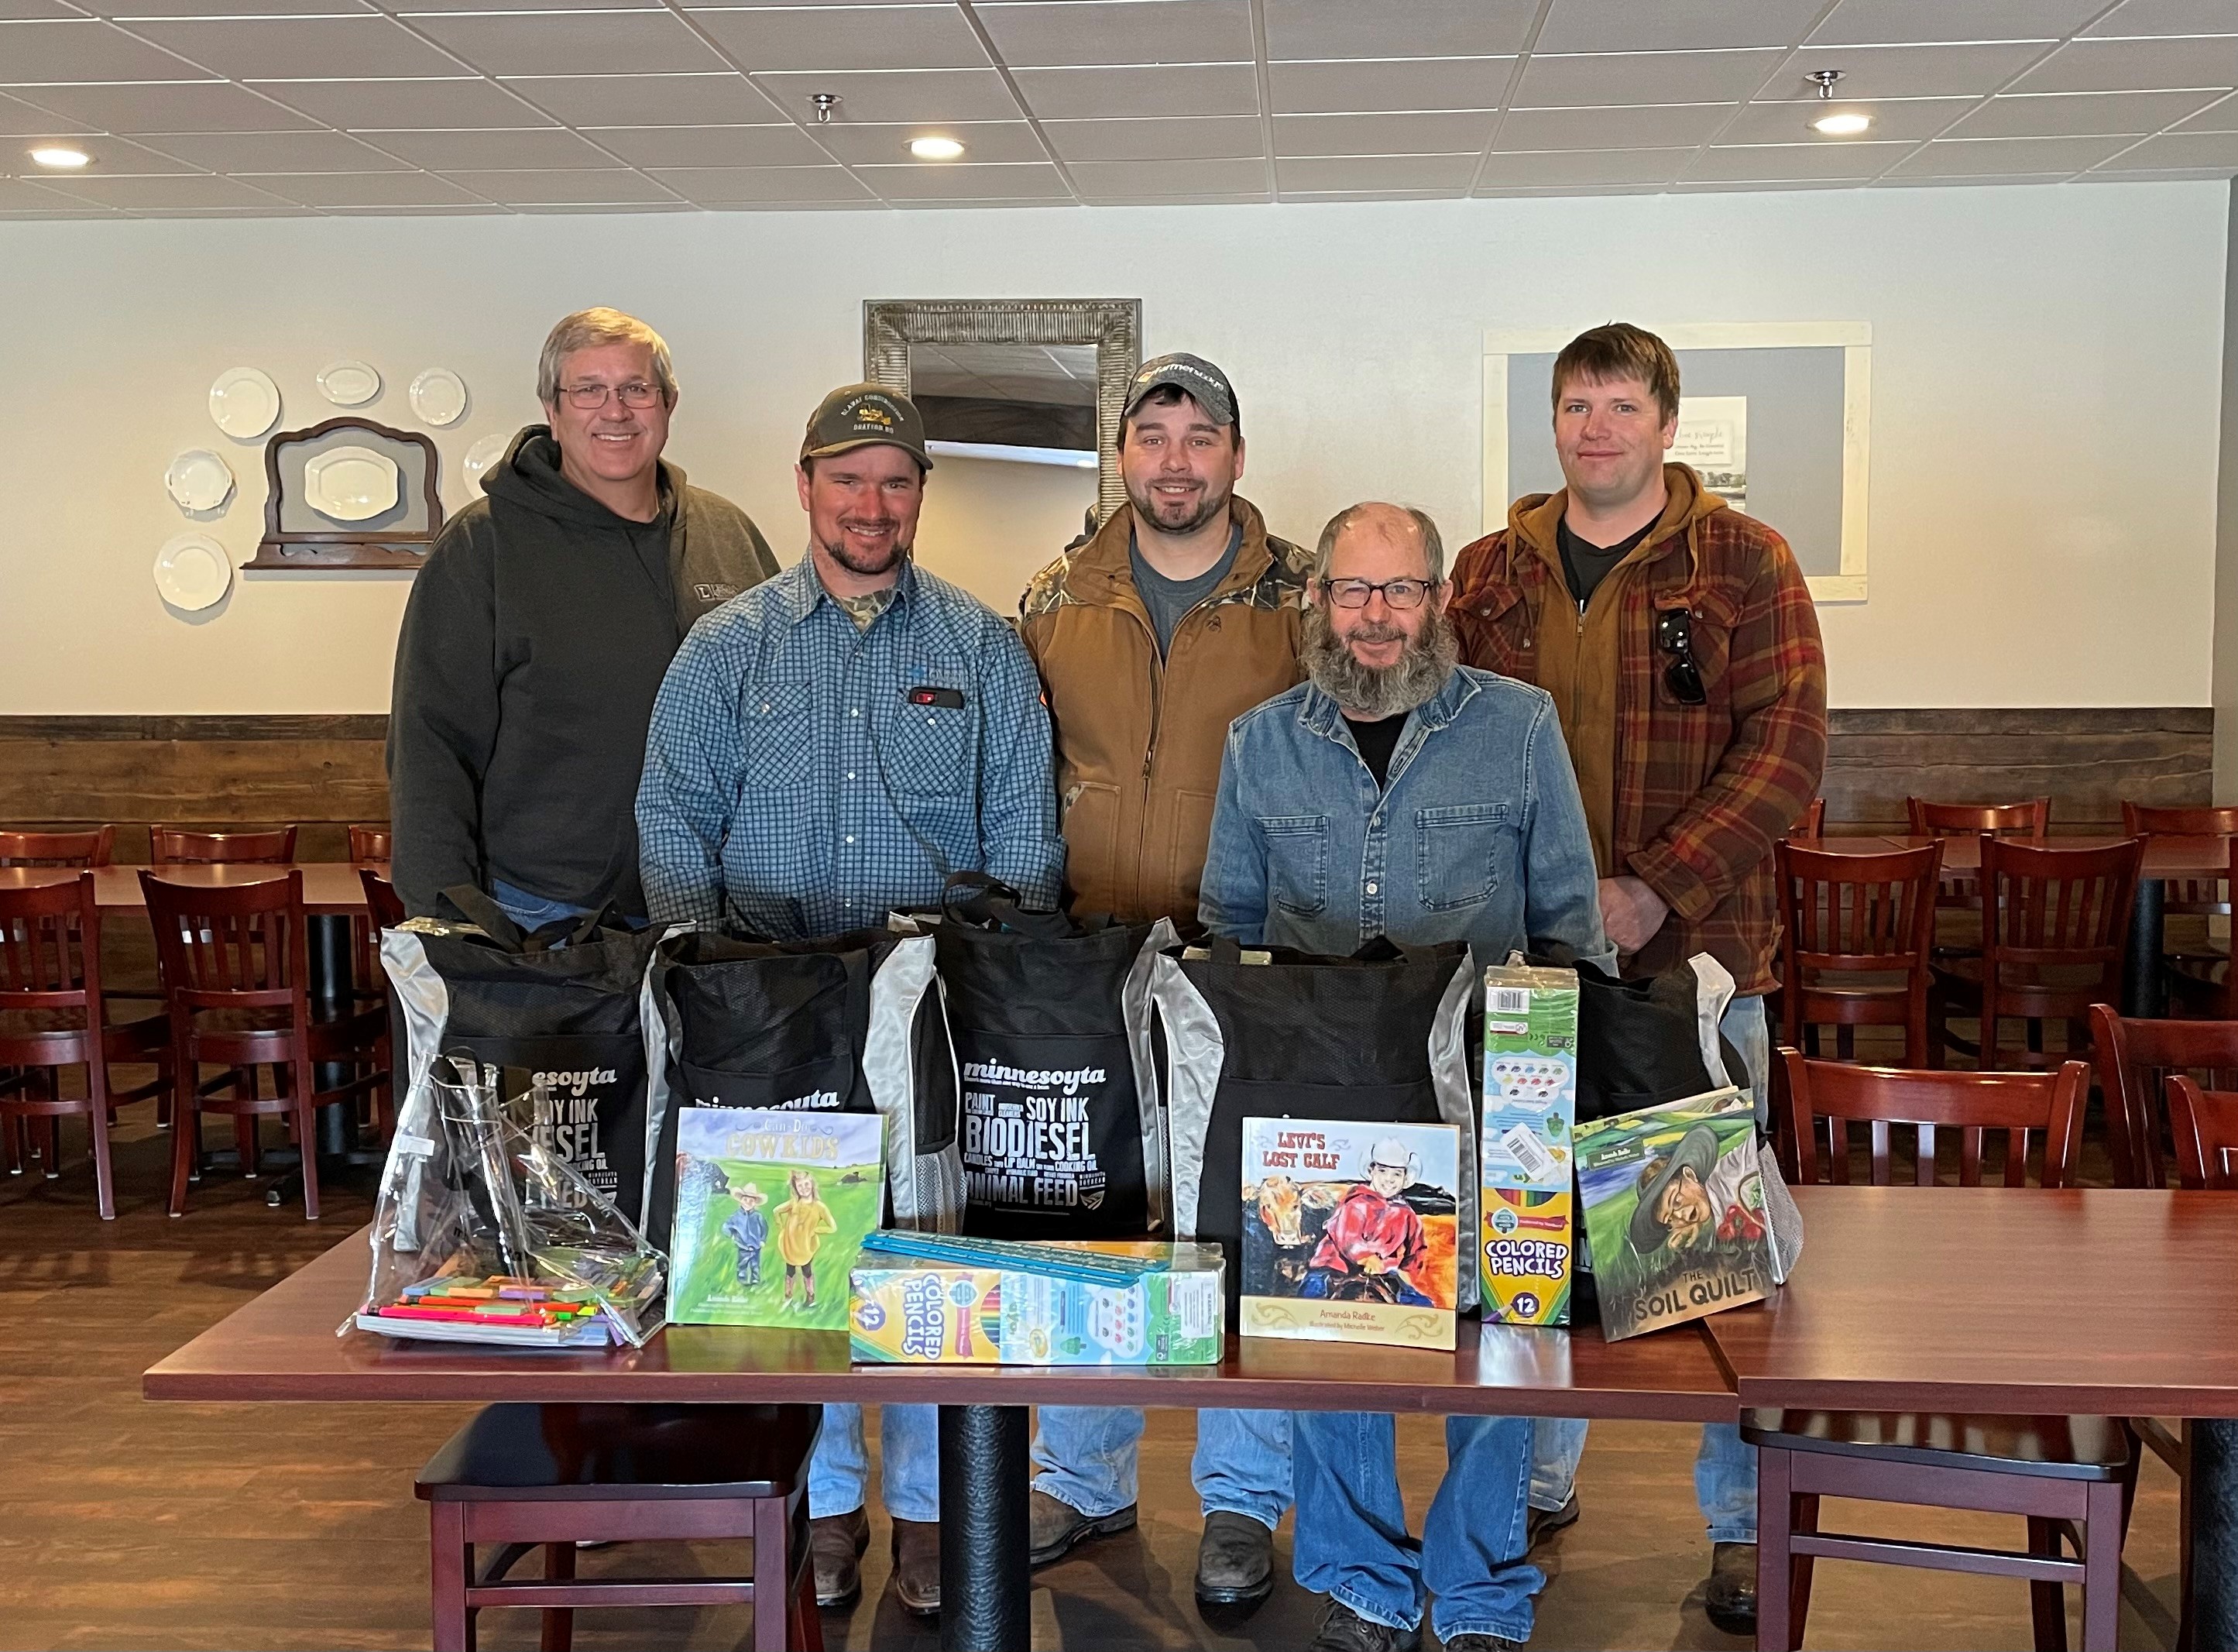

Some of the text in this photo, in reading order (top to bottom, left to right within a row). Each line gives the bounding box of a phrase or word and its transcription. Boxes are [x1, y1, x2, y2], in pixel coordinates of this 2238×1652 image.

[532, 1067, 617, 1097] esoyta
[964, 1058, 1106, 1095] minnesoyta
[569, 1098, 598, 1123] INK
[966, 1092, 996, 1110] PAINT
[1026, 1096, 1089, 1122] SOY INK
[966, 1114, 1096, 1162] BIODIESEL
[1278, 1132, 1325, 1149] LEVI'S
[1055, 1160, 1085, 1172] COOKING
[1263, 1151, 1340, 1169] LOST CALF
[966, 1170, 1078, 1207] ANIMAL FEED
[1486, 1241, 1567, 1259] COLORED
[1491, 1257, 1563, 1278] PENCILS
[1683, 1272, 1704, 1283] THE
[1516, 1297, 1535, 1313] 12
[1635, 1269, 1755, 1321] SOIL QUILT
[903, 1279, 923, 1355] PENCILS
[923, 1274, 943, 1359] COLORED
[1320, 1309, 1376, 1321] Amanda Radke
